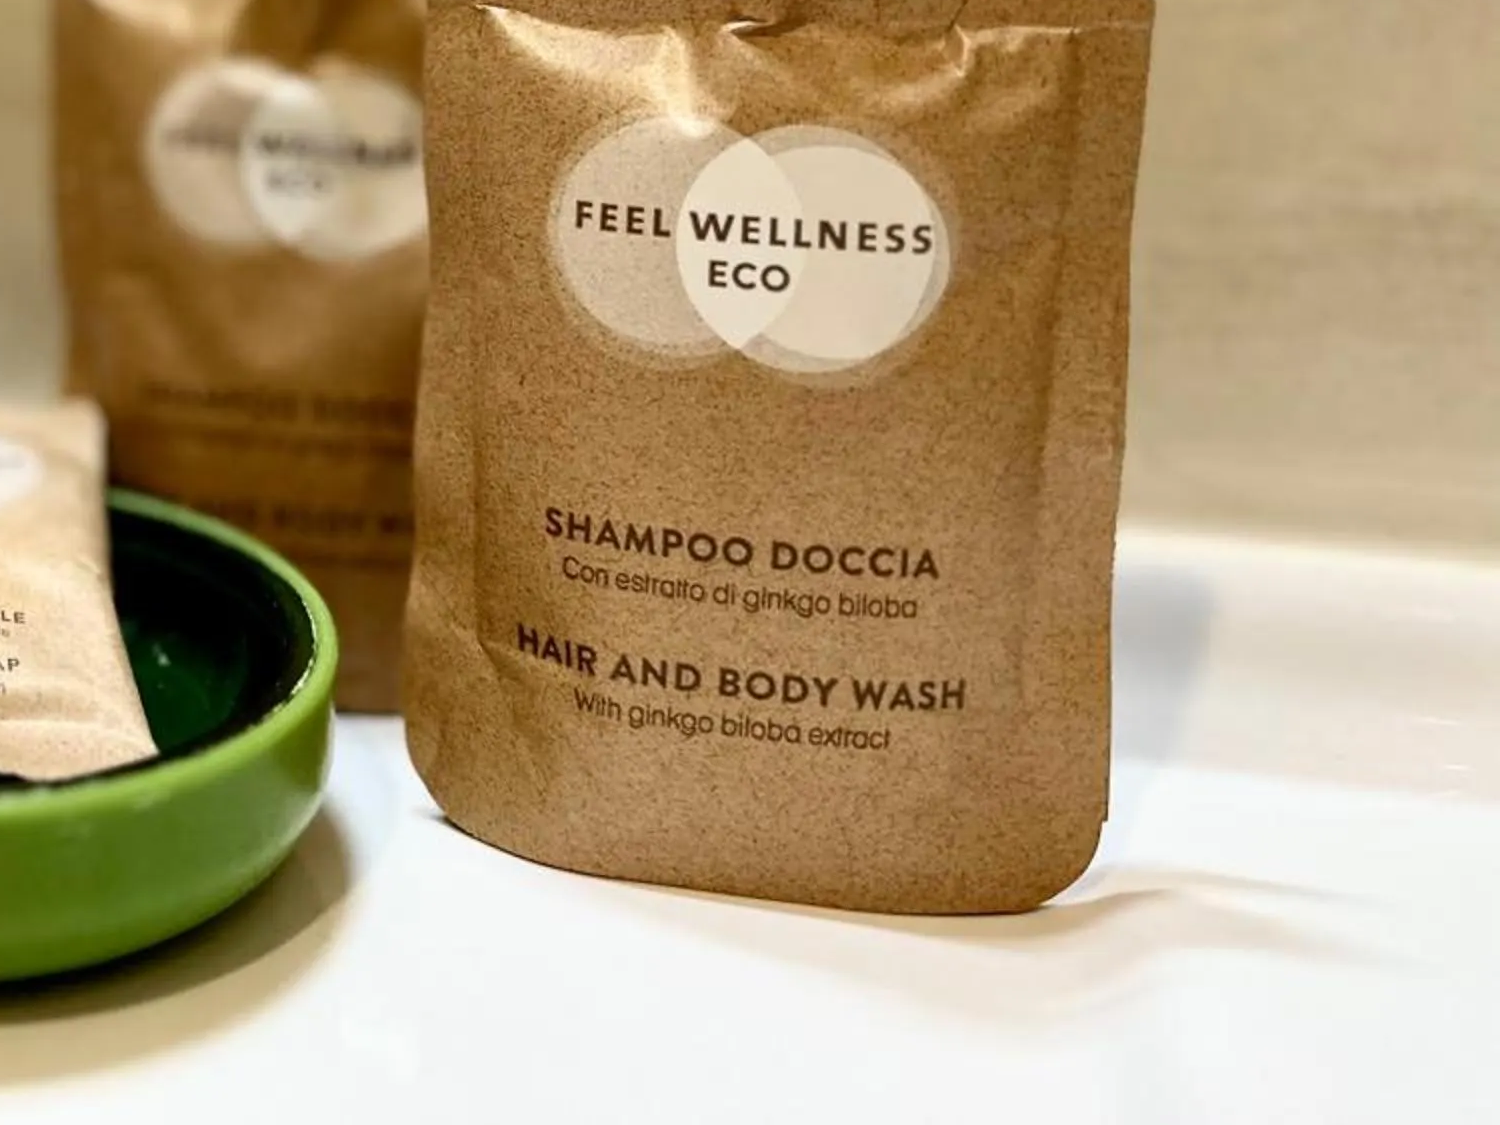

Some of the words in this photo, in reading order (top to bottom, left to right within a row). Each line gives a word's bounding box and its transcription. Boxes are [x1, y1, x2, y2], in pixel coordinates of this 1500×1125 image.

[575, 200, 672, 238] FEEL
[689, 210, 934, 255] WELLNESS
[707, 260, 791, 294] ECO
[544, 506, 754, 567] SHAMPOO
[770, 539, 940, 579] DOCCIA
[562, 555, 609, 588] Con
[614, 570, 706, 603] estratto
[712, 582, 736, 606] di
[742, 586, 832, 619] ginkgo
[838, 592, 918, 619] biloba
[516, 623, 598, 676] HAIR
[609, 653, 701, 692] AND
[717, 666, 839, 708] BODY
[852, 678, 967, 711] WASH
[573, 686, 622, 723] With
[627, 703, 715, 740] ginkgo
[720, 711, 802, 744] biloba
[807, 725, 891, 750] extract
